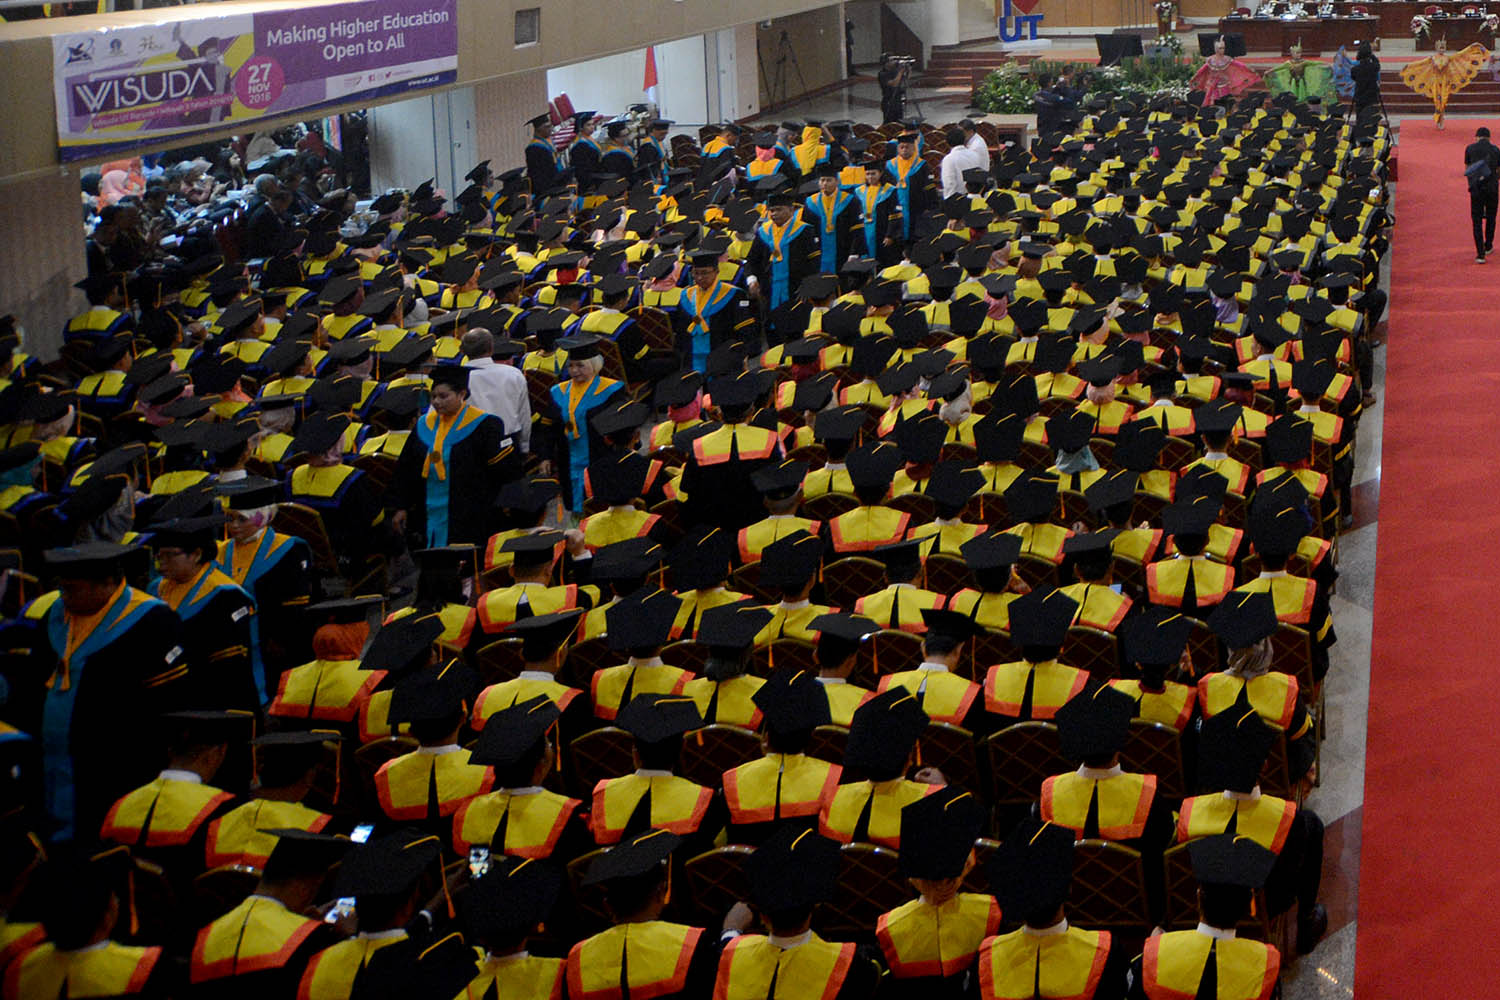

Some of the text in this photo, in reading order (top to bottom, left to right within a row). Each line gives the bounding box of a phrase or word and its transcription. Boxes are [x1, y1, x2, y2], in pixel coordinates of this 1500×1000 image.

[266, 9, 449, 47] Making Higher Education
[998, 14, 1044, 43] UT
[323, 33, 406, 62] Open to All
[248, 63, 272, 84] 27
[76, 67, 214, 112] WISUDA
[248, 83, 271, 94] NOV
[248, 93, 272, 104] 2018
